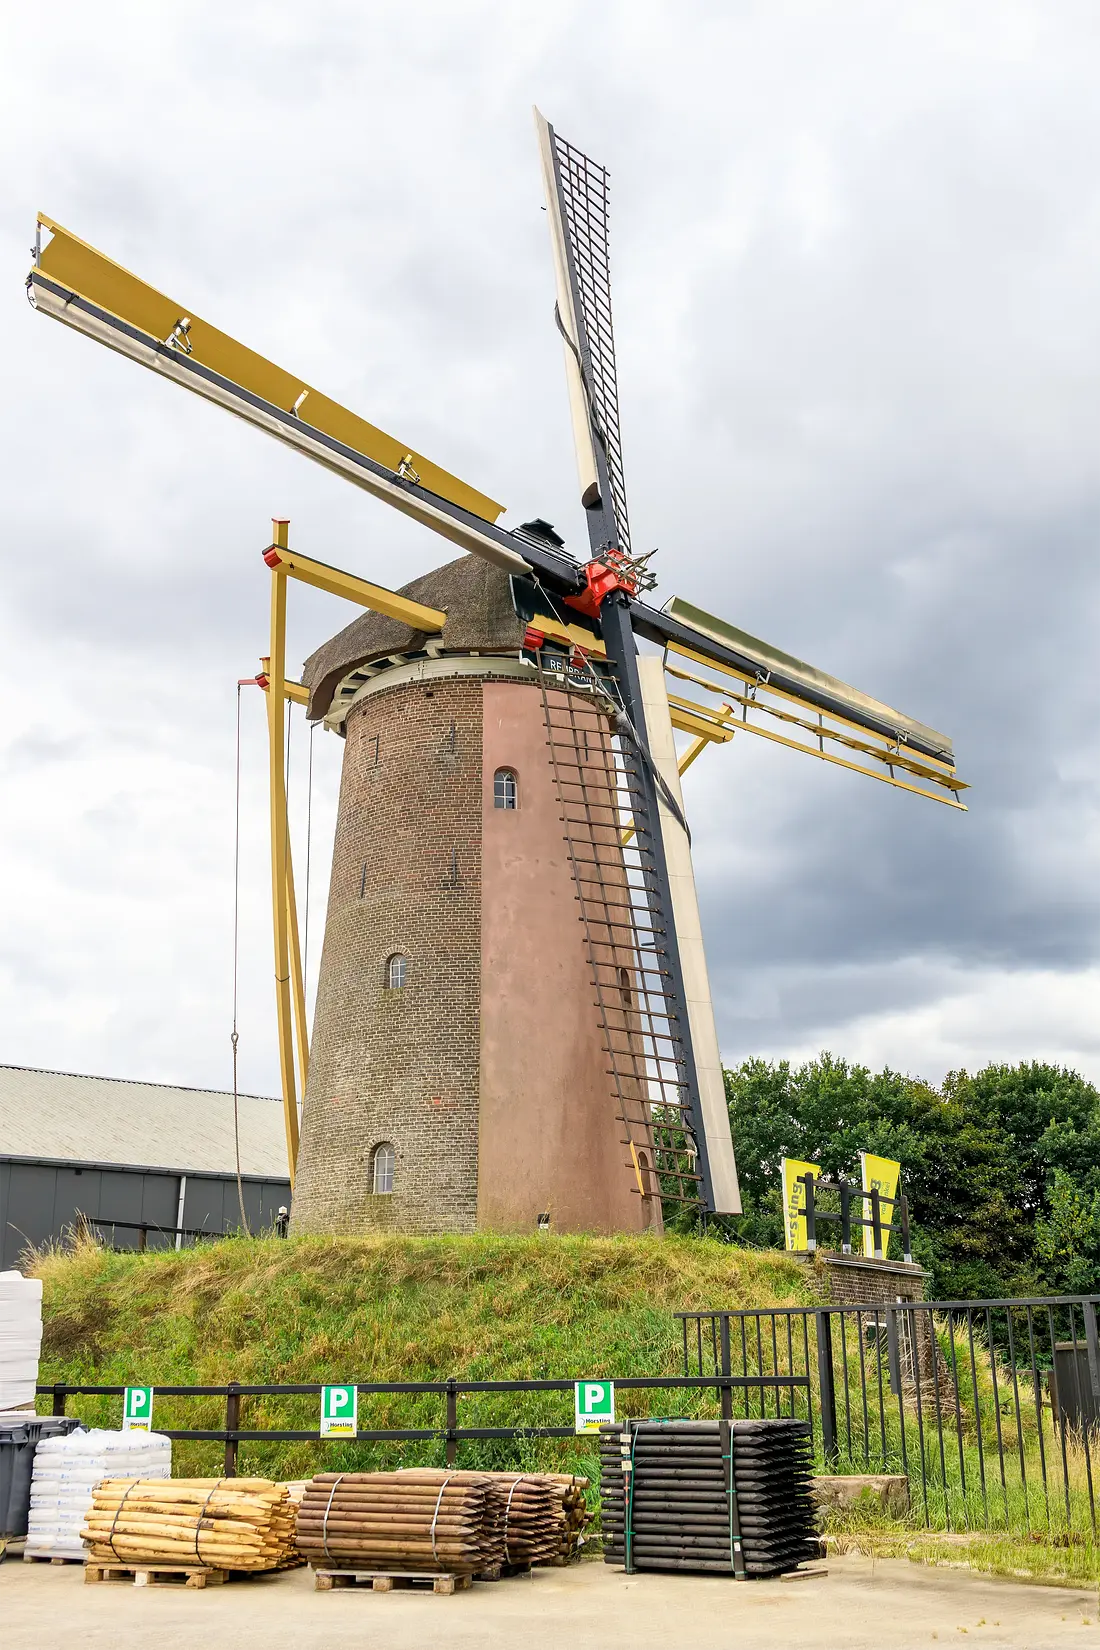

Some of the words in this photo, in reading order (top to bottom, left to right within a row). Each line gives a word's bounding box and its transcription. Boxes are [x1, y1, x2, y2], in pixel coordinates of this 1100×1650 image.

[881, 1181, 891, 1216] vaknkel
[130, 1389, 146, 1416] P
[330, 1388, 349, 1416] P
[585, 1384, 605, 1412] P
